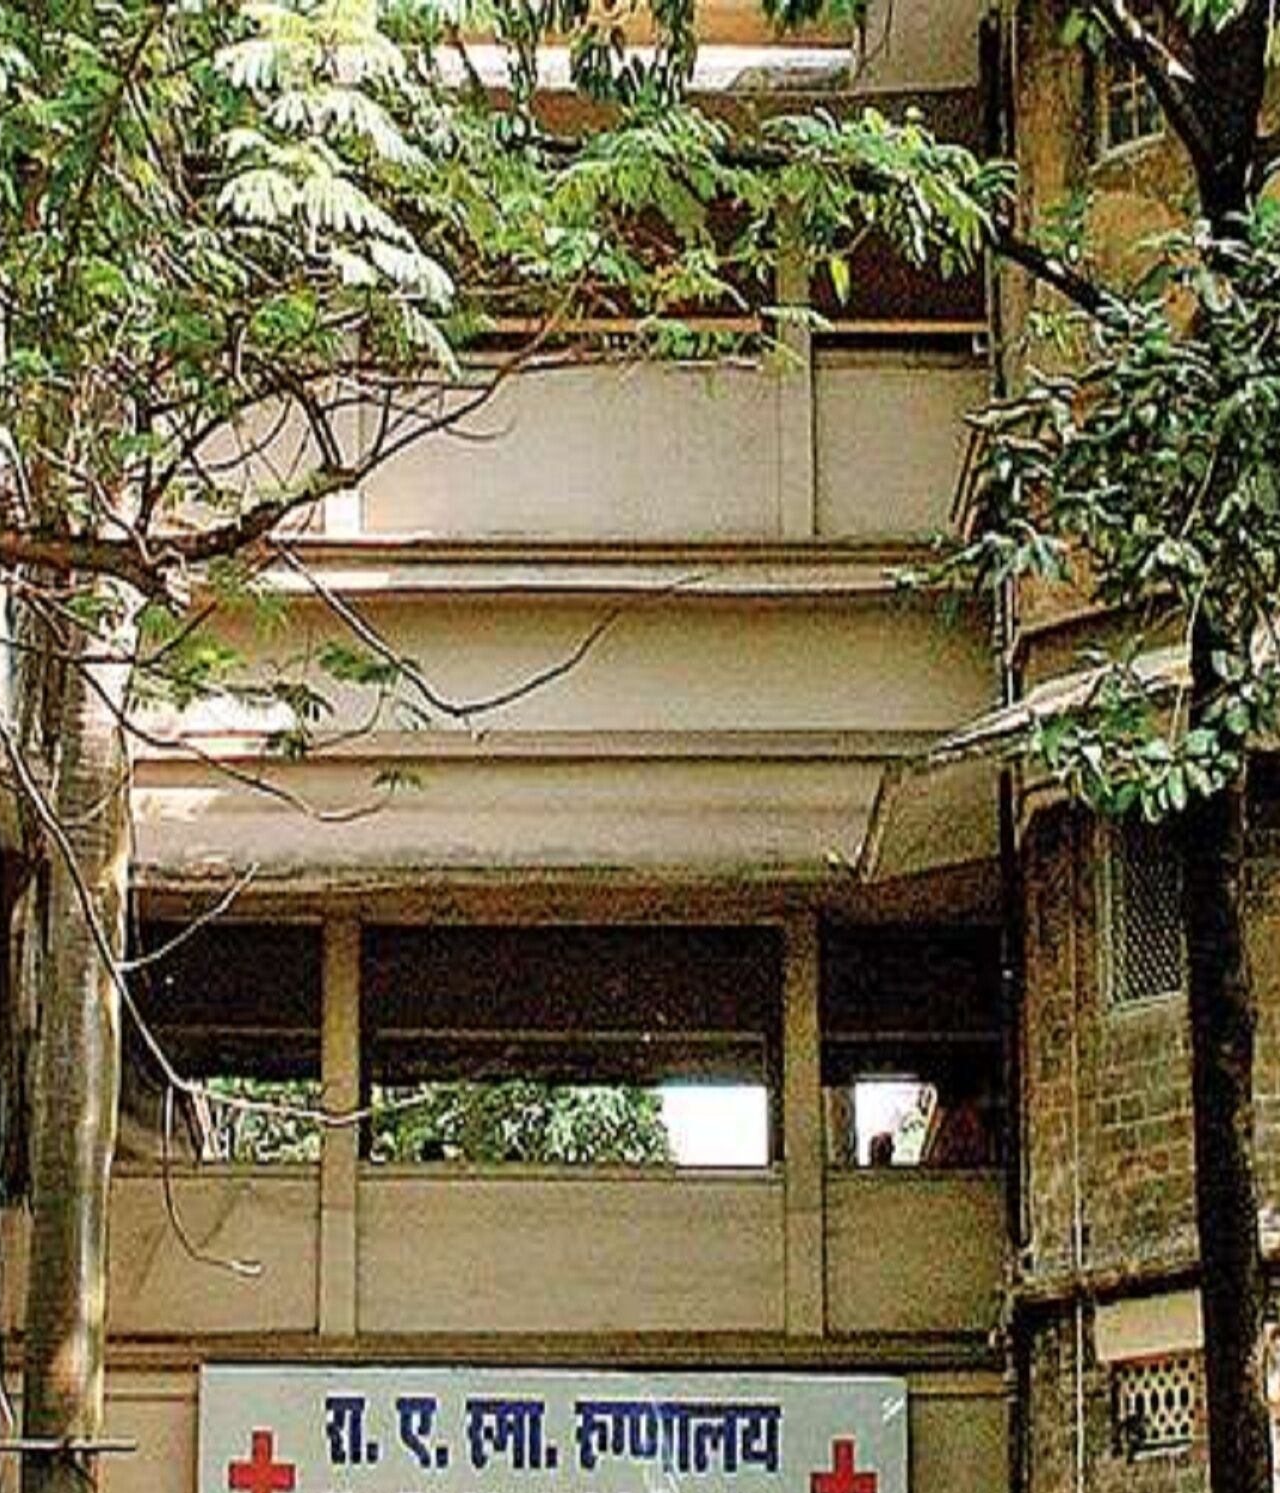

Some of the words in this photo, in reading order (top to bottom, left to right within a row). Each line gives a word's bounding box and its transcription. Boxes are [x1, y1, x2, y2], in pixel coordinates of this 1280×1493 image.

[325, 1397, 379, 1464] रा.
[395, 1397, 449, 1468] ए.
[465, 1400, 558, 1469] स्मा.
[575, 1401, 782, 1473] रुग्णालय
